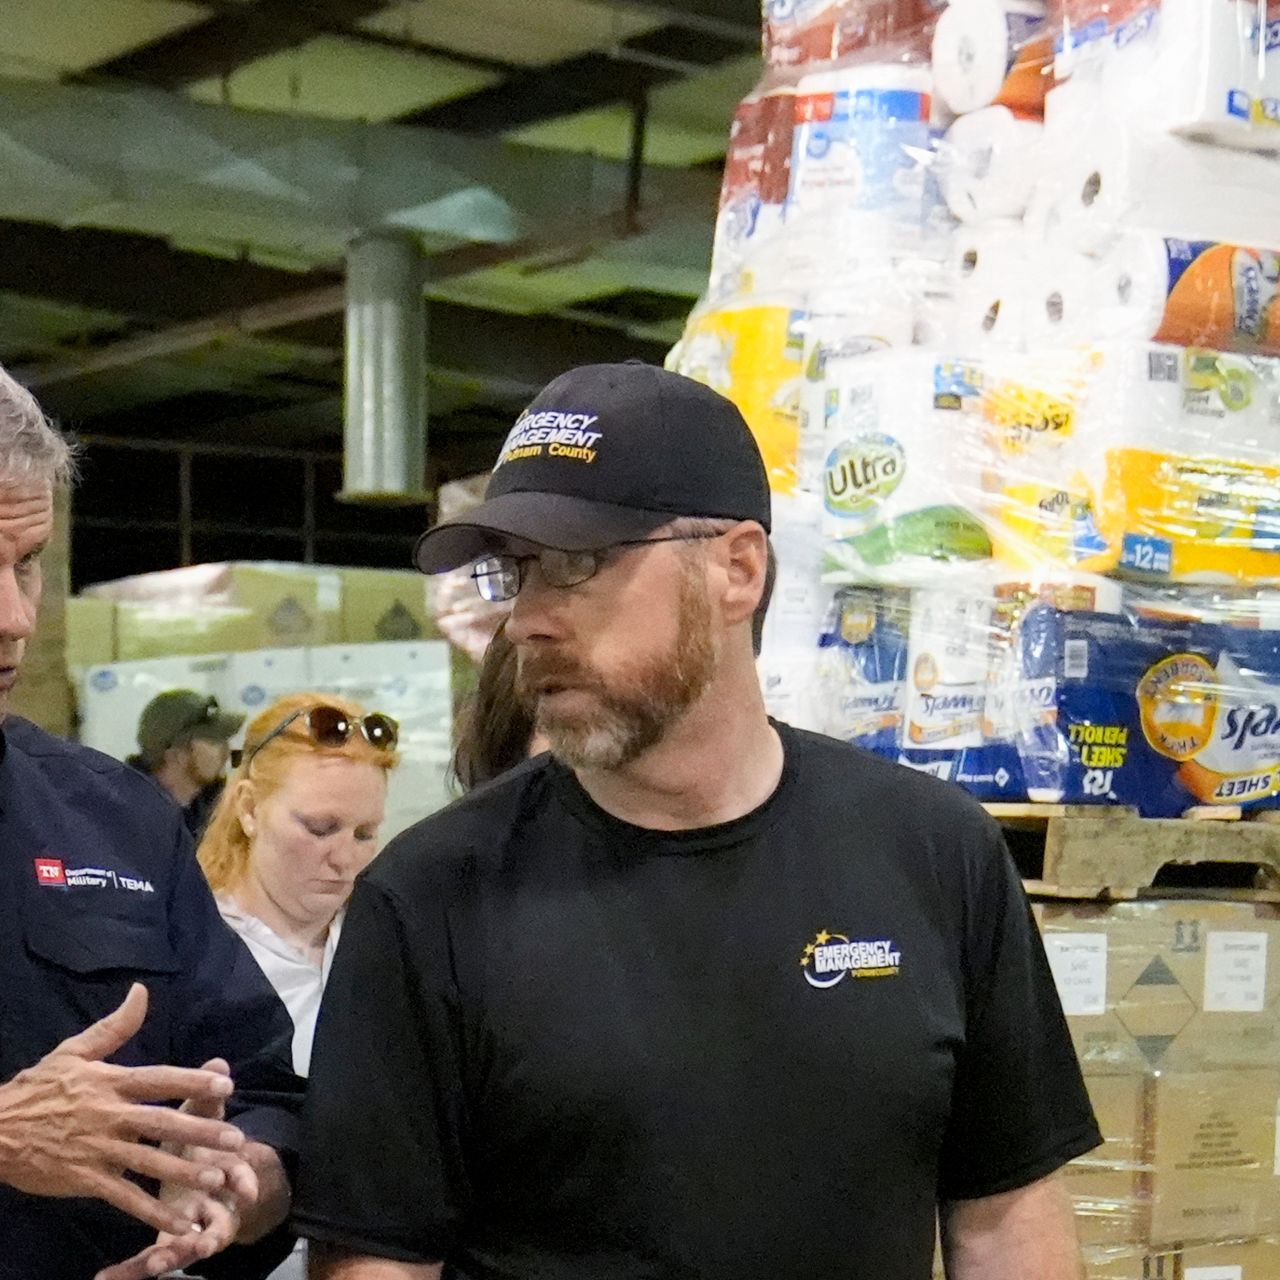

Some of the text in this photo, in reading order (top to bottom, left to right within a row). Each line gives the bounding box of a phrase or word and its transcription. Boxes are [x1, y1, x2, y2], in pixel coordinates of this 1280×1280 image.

[548, 443, 596, 463] County
[828, 456, 897, 496] Ultra
[1068, 725, 1103, 743] ROLL
[1215, 775, 1271, 797] SHEET
[39, 865, 60, 878] TN
[67, 876, 155, 892] Military TEMA
[814, 940, 892, 957] EMERGENCY
[815, 951, 902, 973] MANAGEMENT
